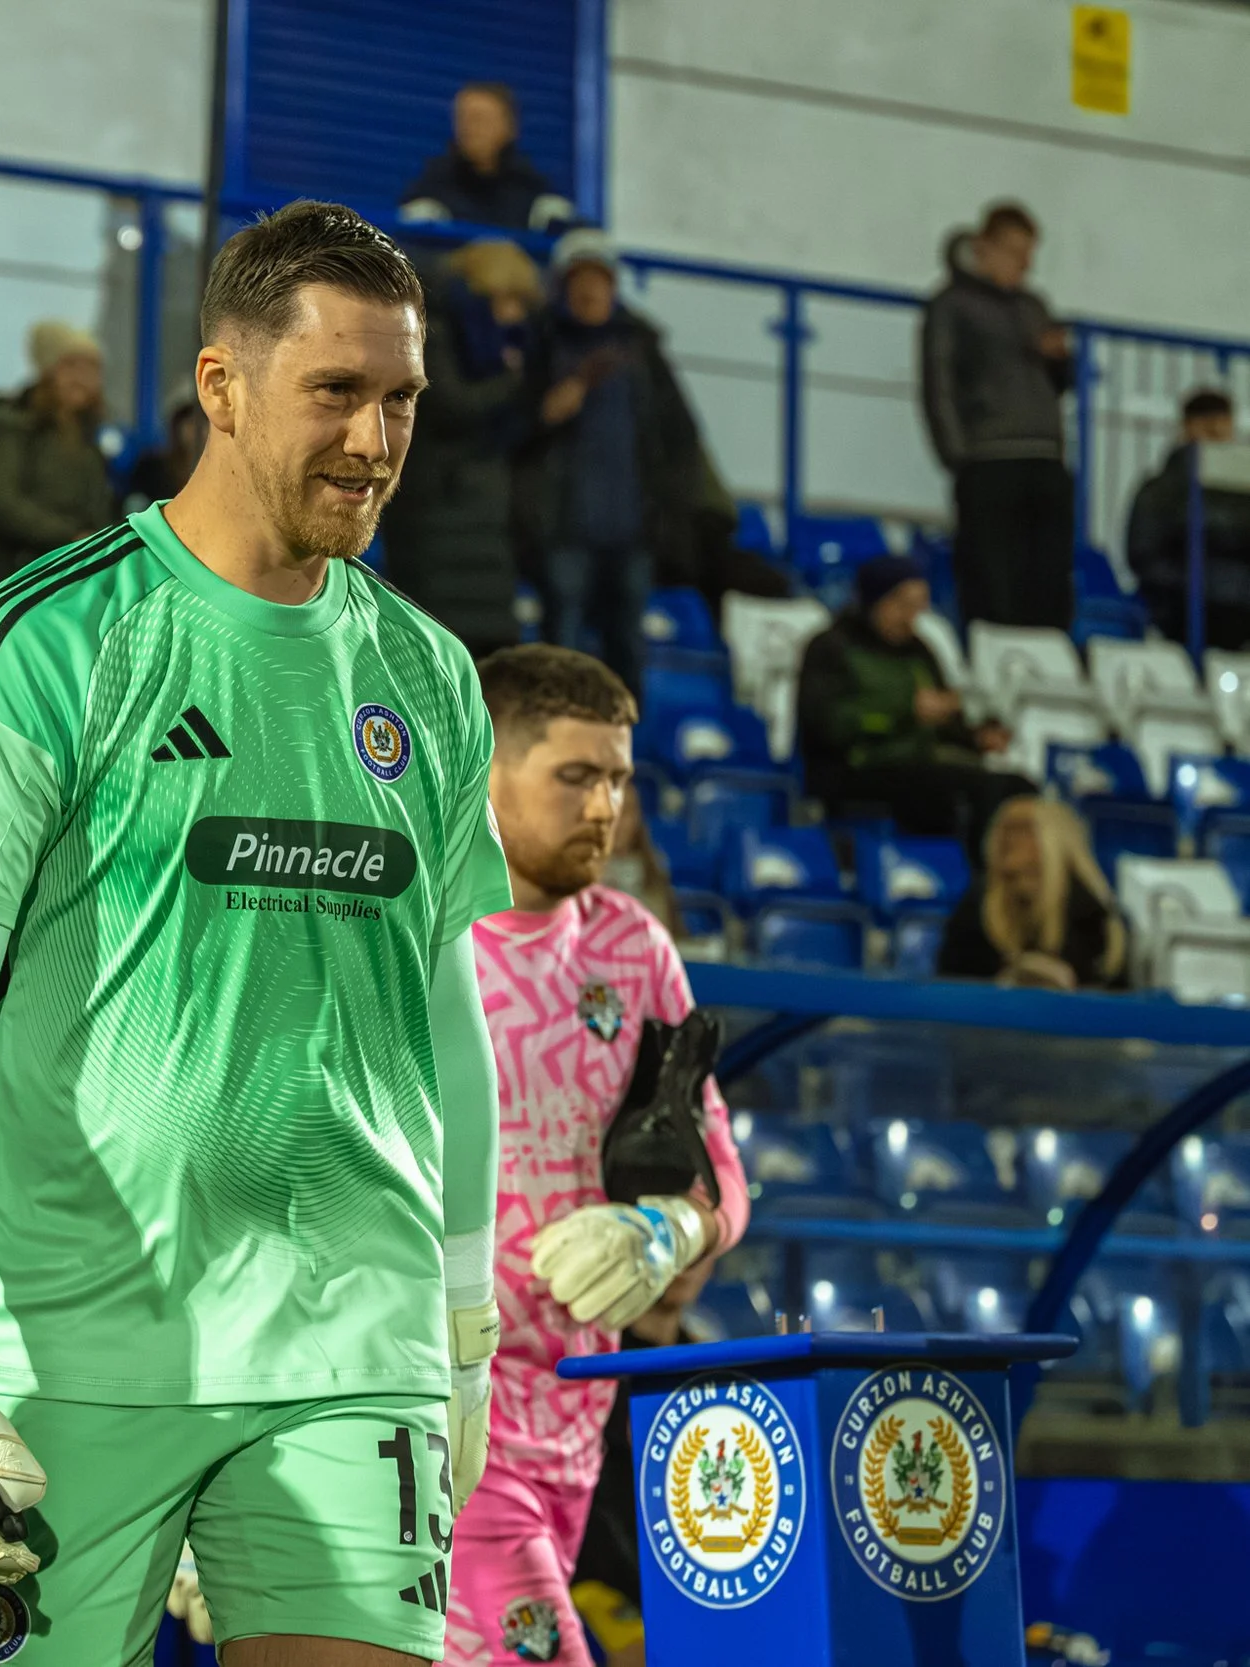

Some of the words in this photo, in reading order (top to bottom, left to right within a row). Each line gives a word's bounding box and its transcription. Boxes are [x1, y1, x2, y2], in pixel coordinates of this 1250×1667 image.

[225, 832, 386, 883] Pinnacle
[225, 890, 310, 914] Electrical
[315, 894, 382, 922] Supplies
[650, 1381, 718, 1463] CURZON
[725, 1381, 796, 1466] ASHTON
[842, 1369, 912, 1451] CURZON
[921, 1373, 995, 1463] ASHTON
[377, 1426, 454, 1555] 13
[652, 1519, 748, 1601] FOOTBALL
[753, 1516, 794, 1583] CLUB
[846, 1508, 948, 1593] FOOTBALL
[953, 1512, 994, 1578] CLUB
